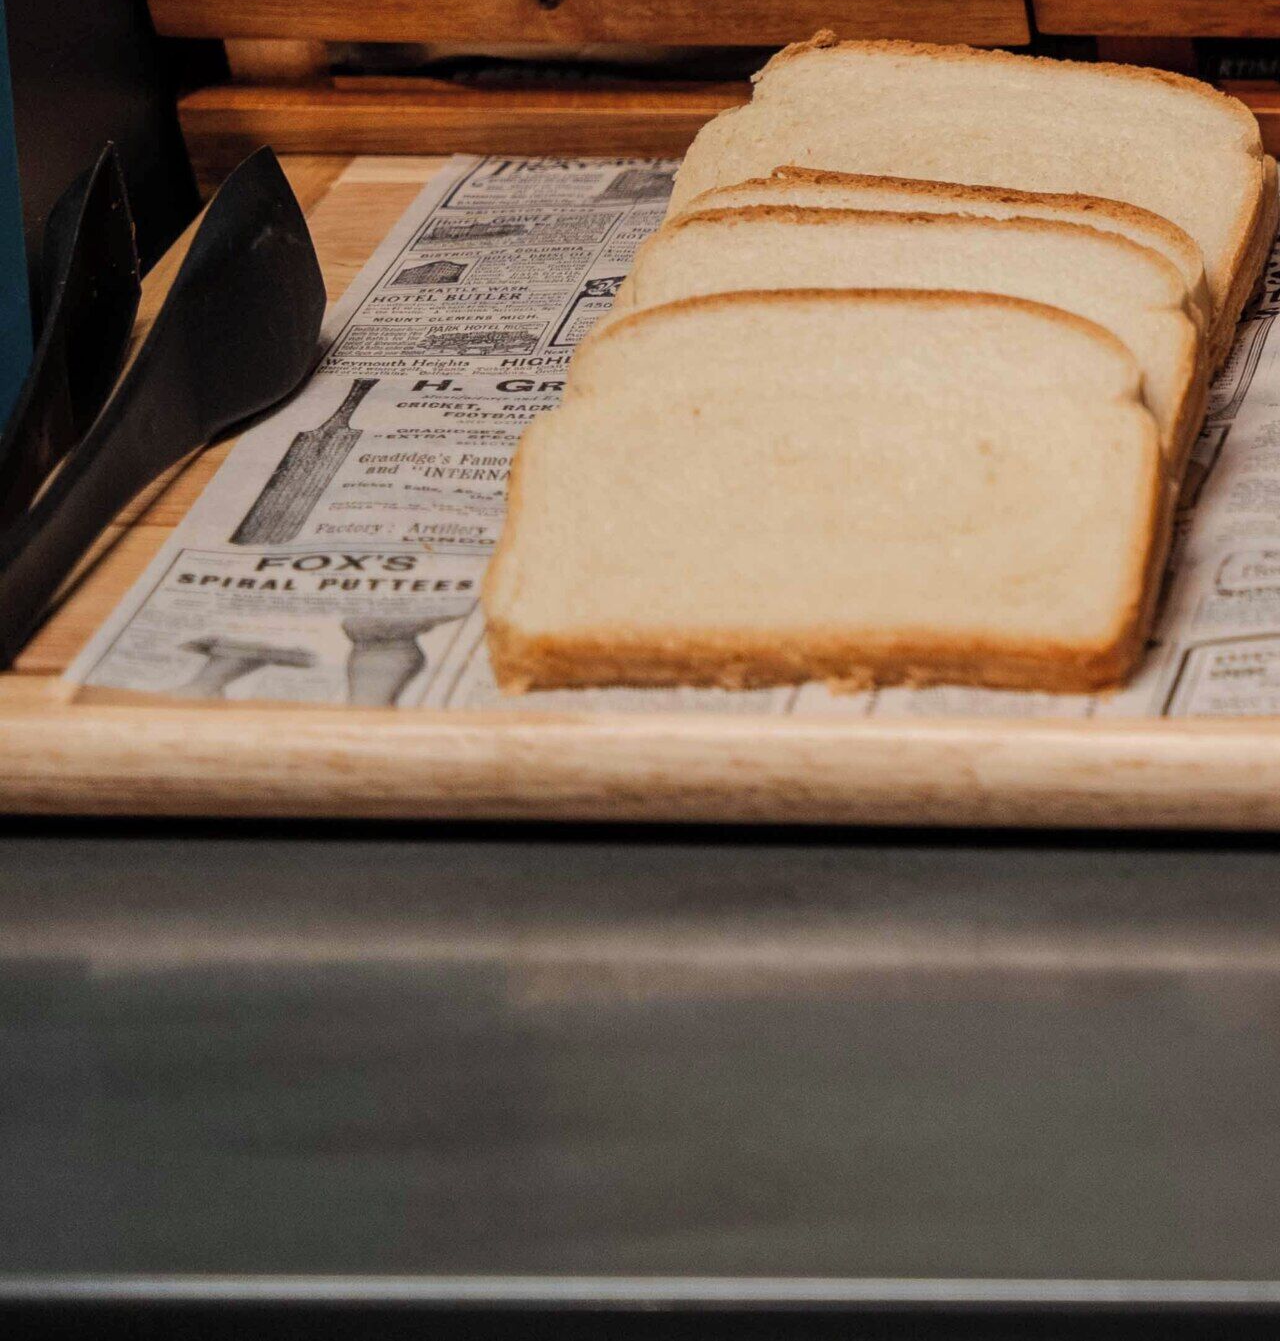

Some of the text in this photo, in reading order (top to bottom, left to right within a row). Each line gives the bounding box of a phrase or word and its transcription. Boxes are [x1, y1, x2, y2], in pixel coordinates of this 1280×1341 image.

[371, 295, 437, 303] HOTEL
[444, 293, 522, 301] BUTLER
[325, 358, 407, 368] Weymouth
[413, 359, 471, 369] Heights
[411, 379, 464, 392] H.
[396, 402, 561, 412] CRICKET, RACK
[357, 452, 453, 465] Gradidge's
[364, 464, 400, 476] and
[407, 521, 489, 537] Artillery
[255, 554, 419, 572] FOX'S
[177, 573, 475, 592] SPIRAL PUTTEES
